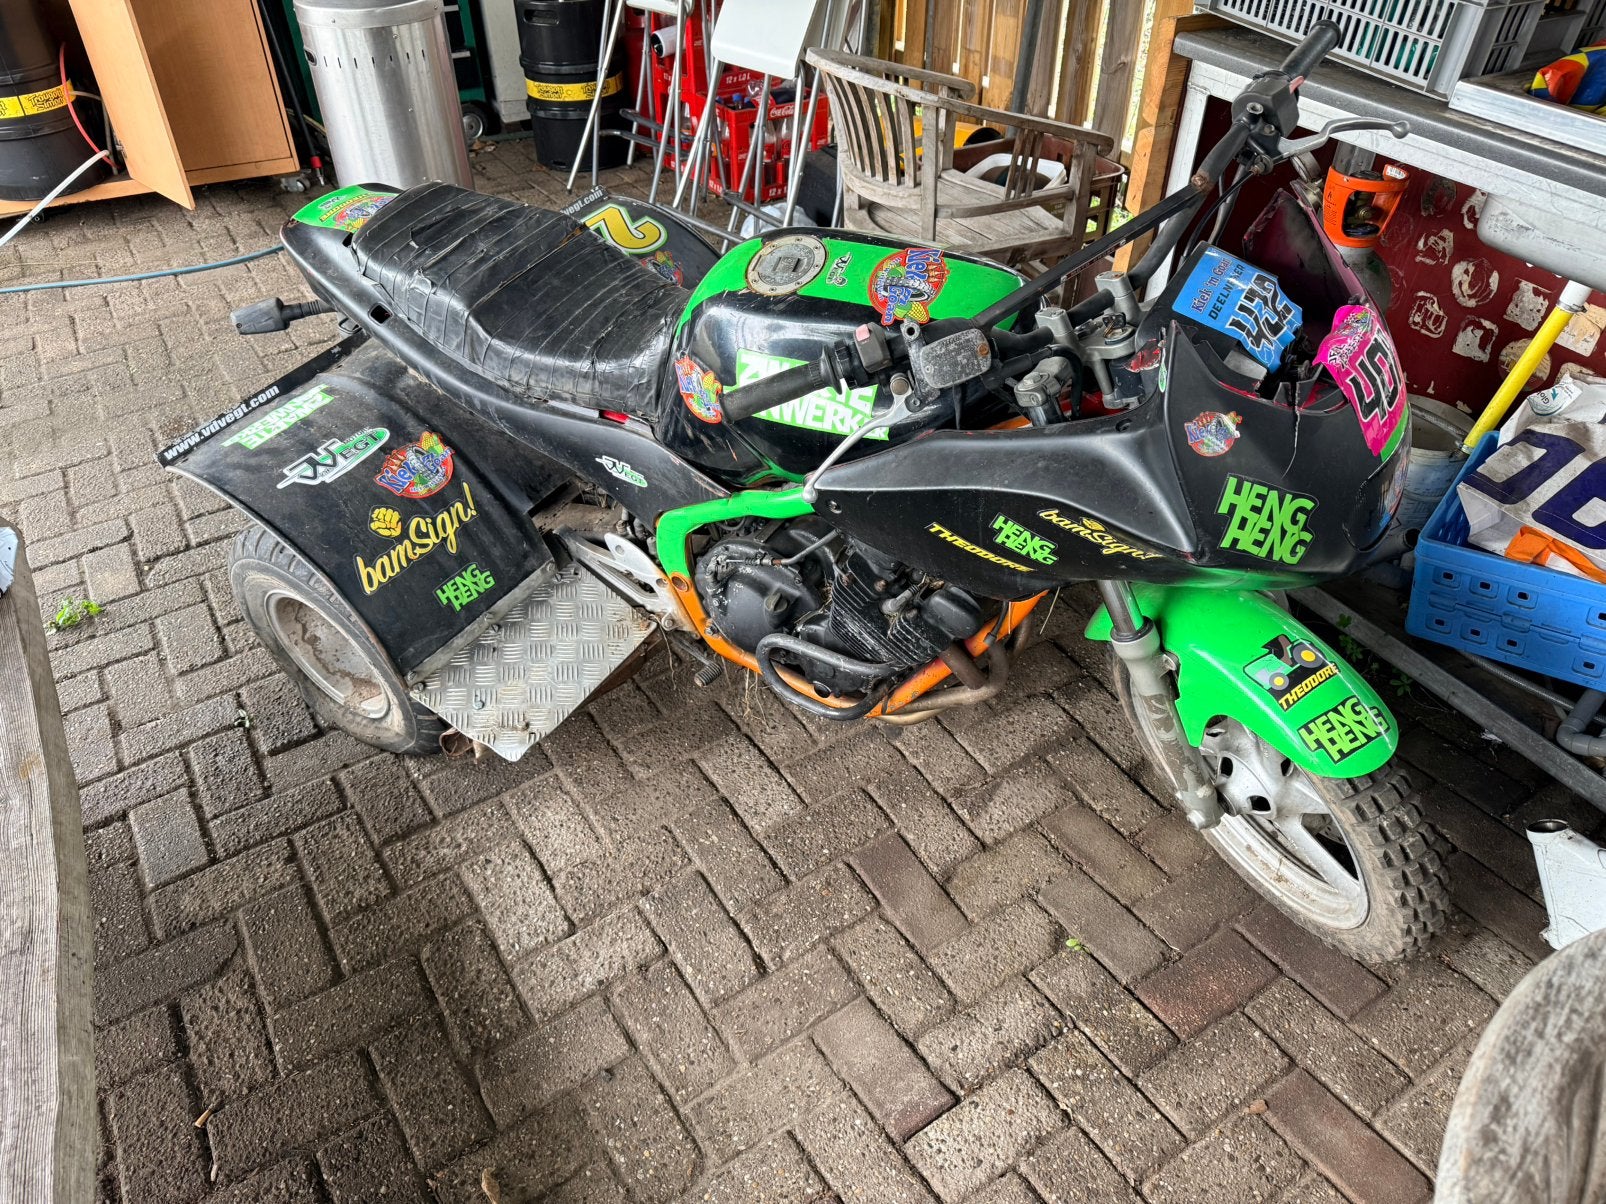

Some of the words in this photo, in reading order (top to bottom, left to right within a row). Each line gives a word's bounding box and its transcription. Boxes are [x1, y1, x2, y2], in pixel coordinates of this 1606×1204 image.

[560, 189, 603, 217] vegt.com
[164, 385, 280, 460] www.vdvegt.com
[1217, 476, 1315, 532] HENG
[356, 481, 477, 594] bamSign!
[928, 523, 1036, 573] THEODORE
[992, 515, 1056, 553] HENG
[995, 531, 1058, 565] HENG
[1220, 502, 1314, 565] HENG
[435, 563, 481, 606] HENG
[451, 570, 496, 612] HENG
[1278, 662, 1340, 710] THEODORE
[1298, 697, 1366, 751] HENG
[1320, 708, 1389, 761] HENG
